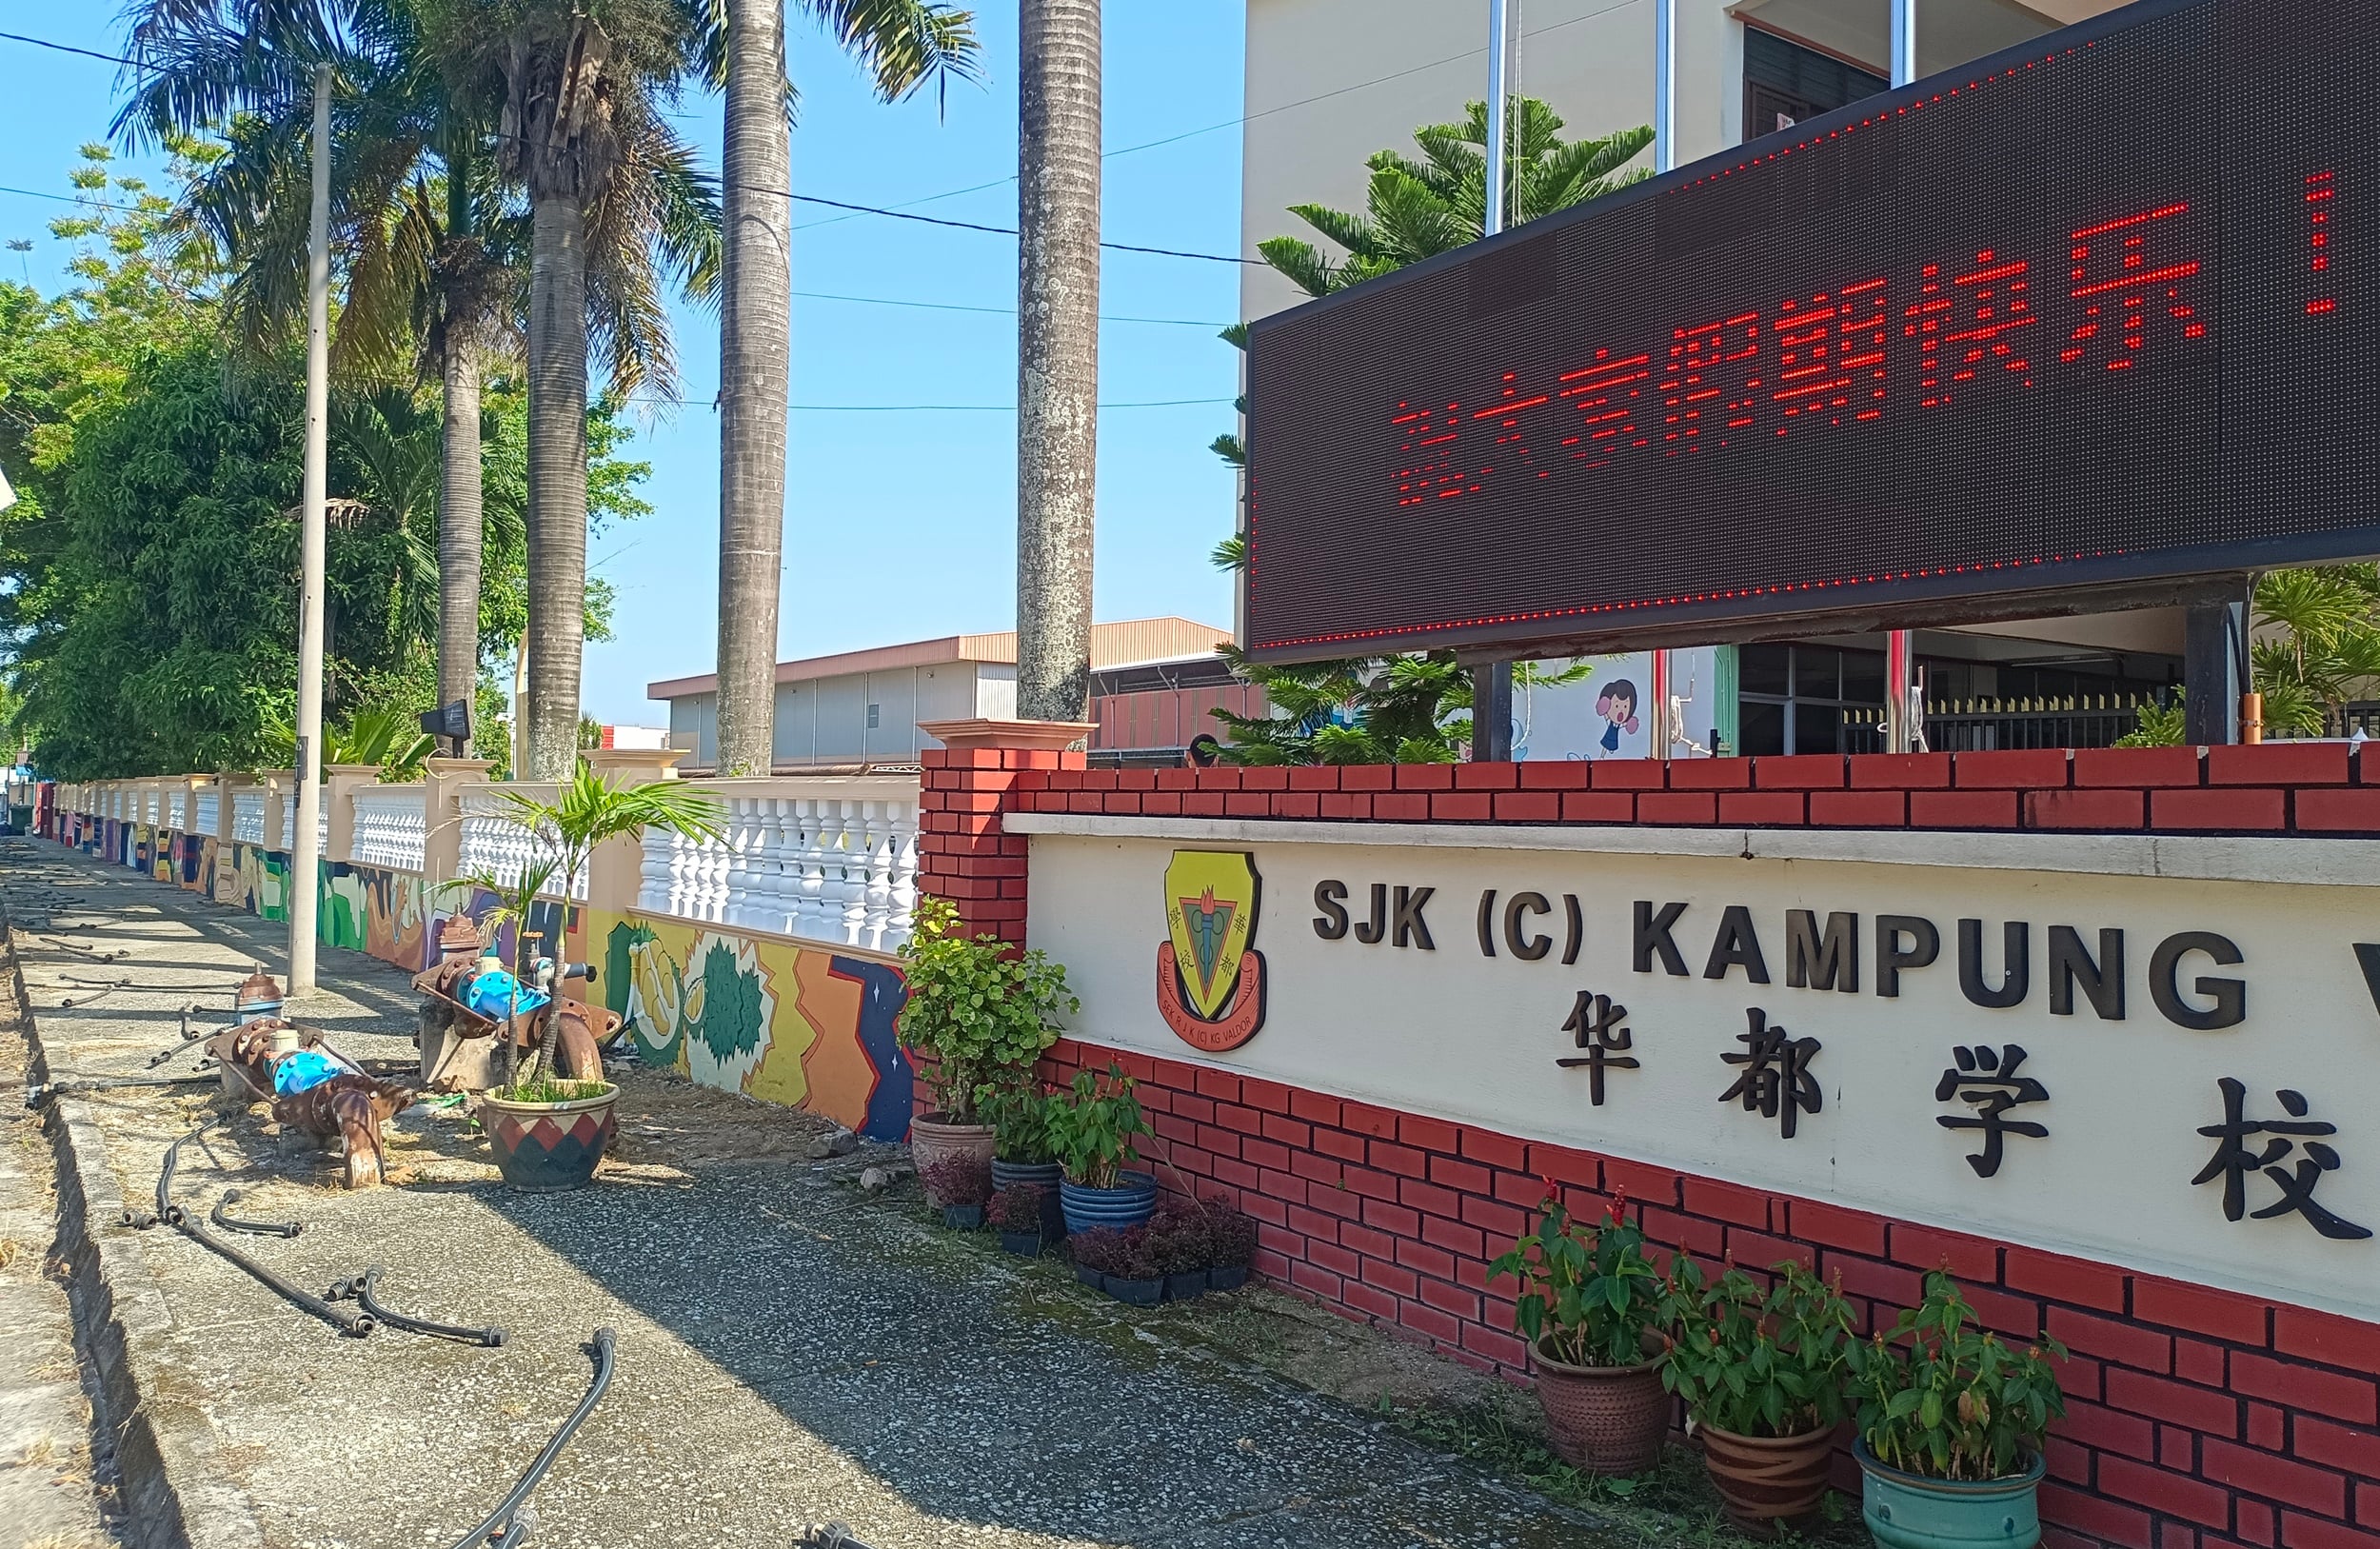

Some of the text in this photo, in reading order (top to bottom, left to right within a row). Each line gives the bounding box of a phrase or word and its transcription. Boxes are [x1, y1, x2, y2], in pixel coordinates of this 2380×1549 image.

[1161, 1000, 1175, 1018] SEK
[1176, 1016, 1181, 1026] R
[1189, 1027, 1195, 1039] K
[1197, 1030, 1208, 1045] (C)
[1210, 1032, 1221, 1044] KG
[1222, 1015, 1253, 1043] VALDOR
[1312, 878, 2248, 1032] SJK (C) KAMPUNG
[1556, 988, 2373, 1241] 华都学校
